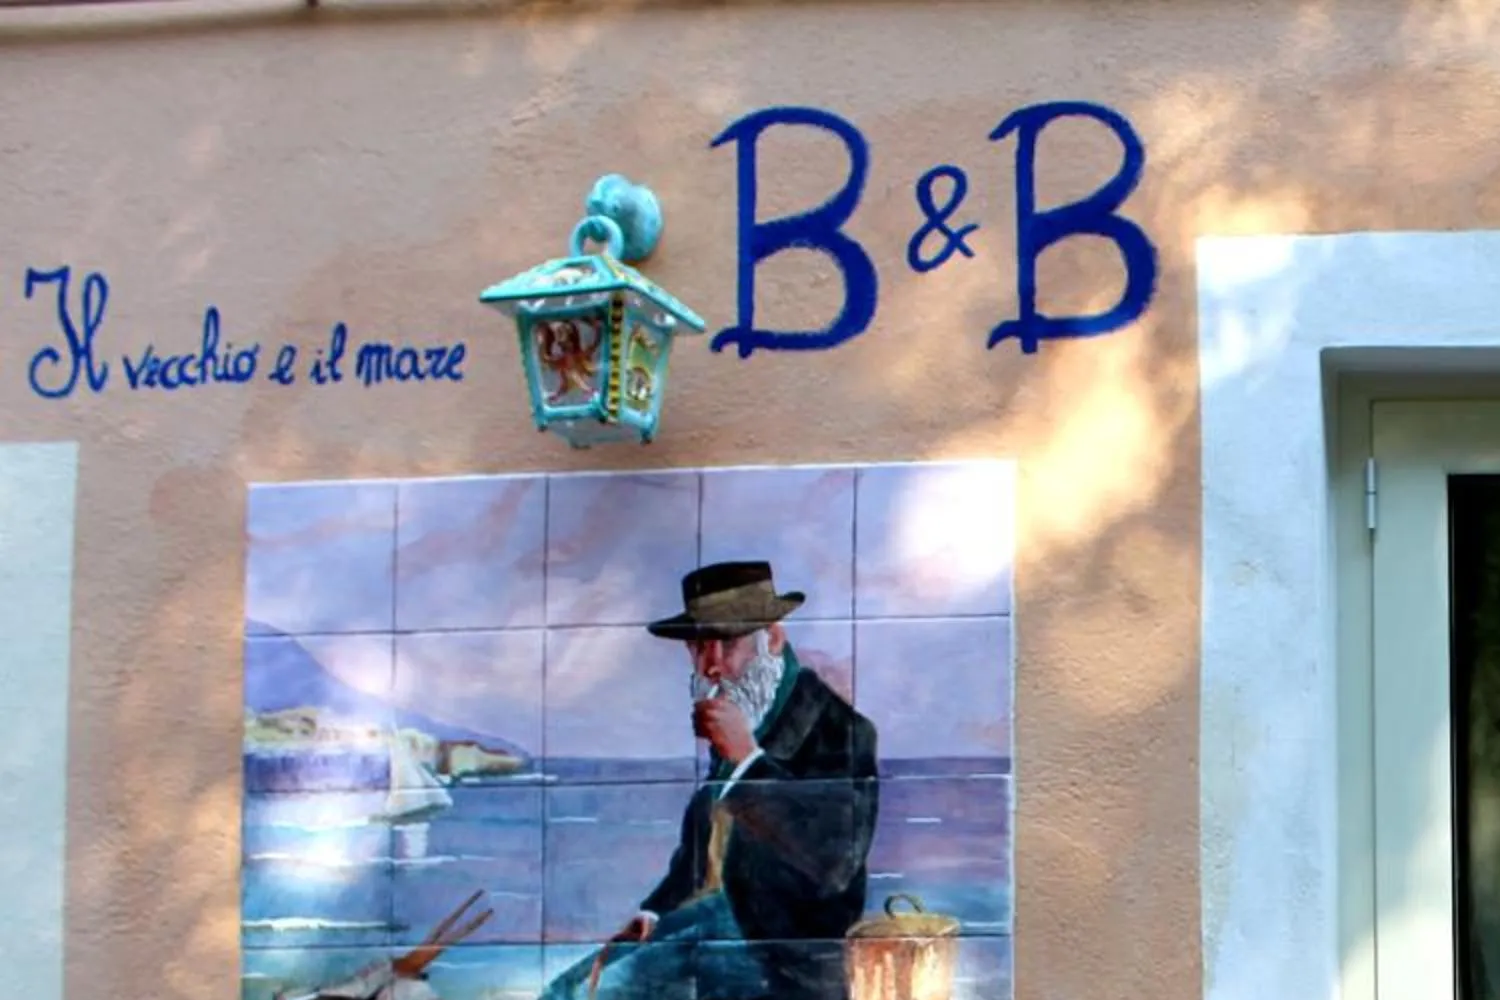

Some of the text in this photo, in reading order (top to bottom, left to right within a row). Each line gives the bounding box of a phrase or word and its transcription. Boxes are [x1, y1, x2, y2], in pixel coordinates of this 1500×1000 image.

[24, 265, 467, 399] Il vecchio e il mare
